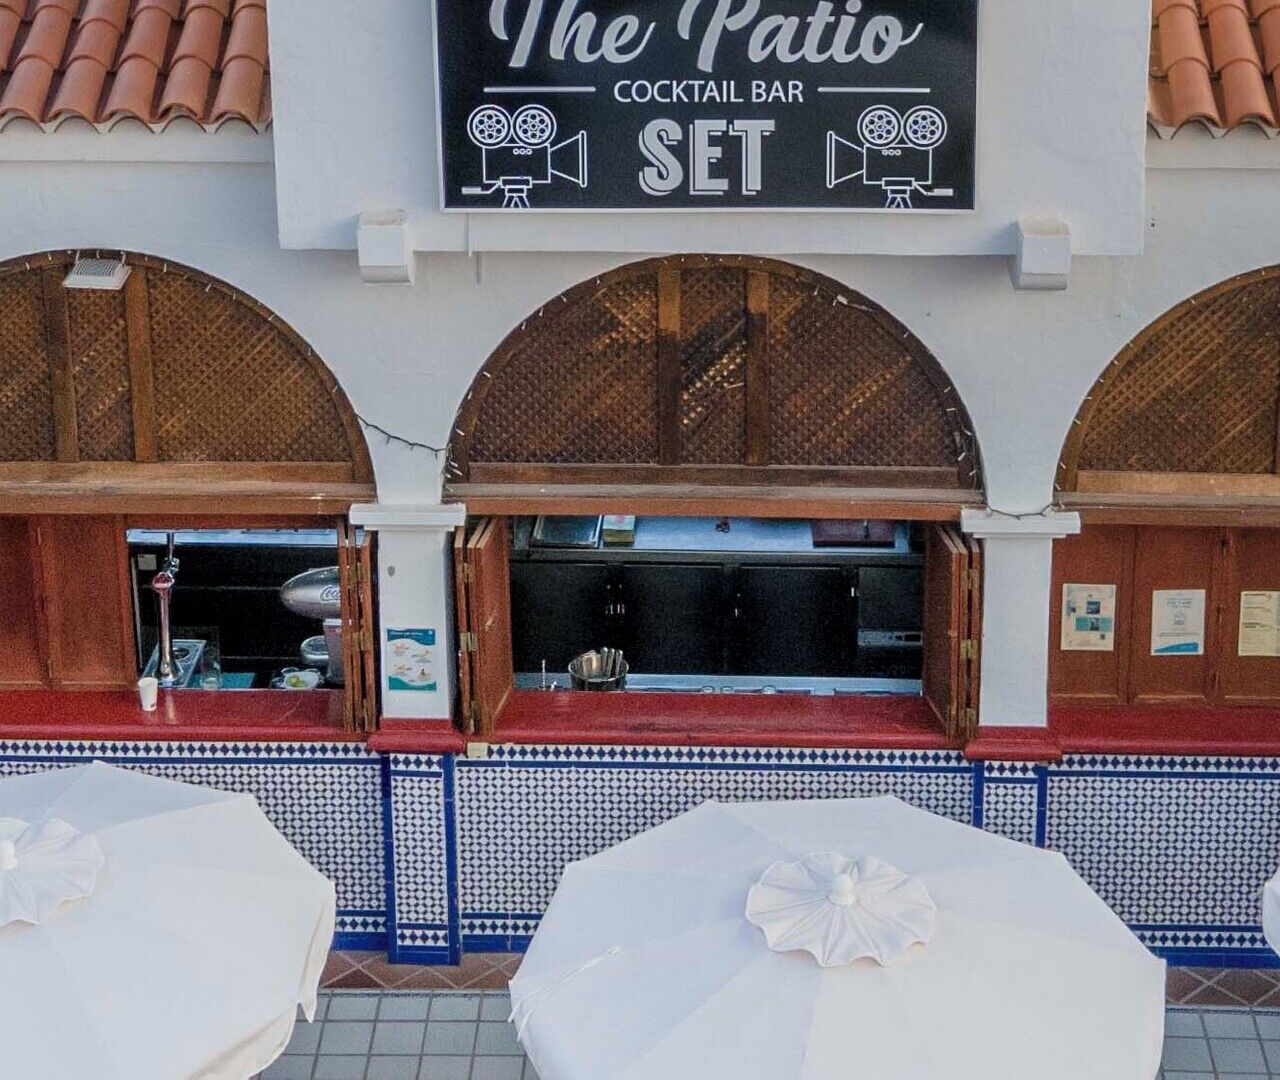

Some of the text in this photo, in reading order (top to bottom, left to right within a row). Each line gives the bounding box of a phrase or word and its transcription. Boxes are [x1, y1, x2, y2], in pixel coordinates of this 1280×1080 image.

[613, 79, 805, 104] COCKTAIL BAR
[638, 117, 777, 197] SET
